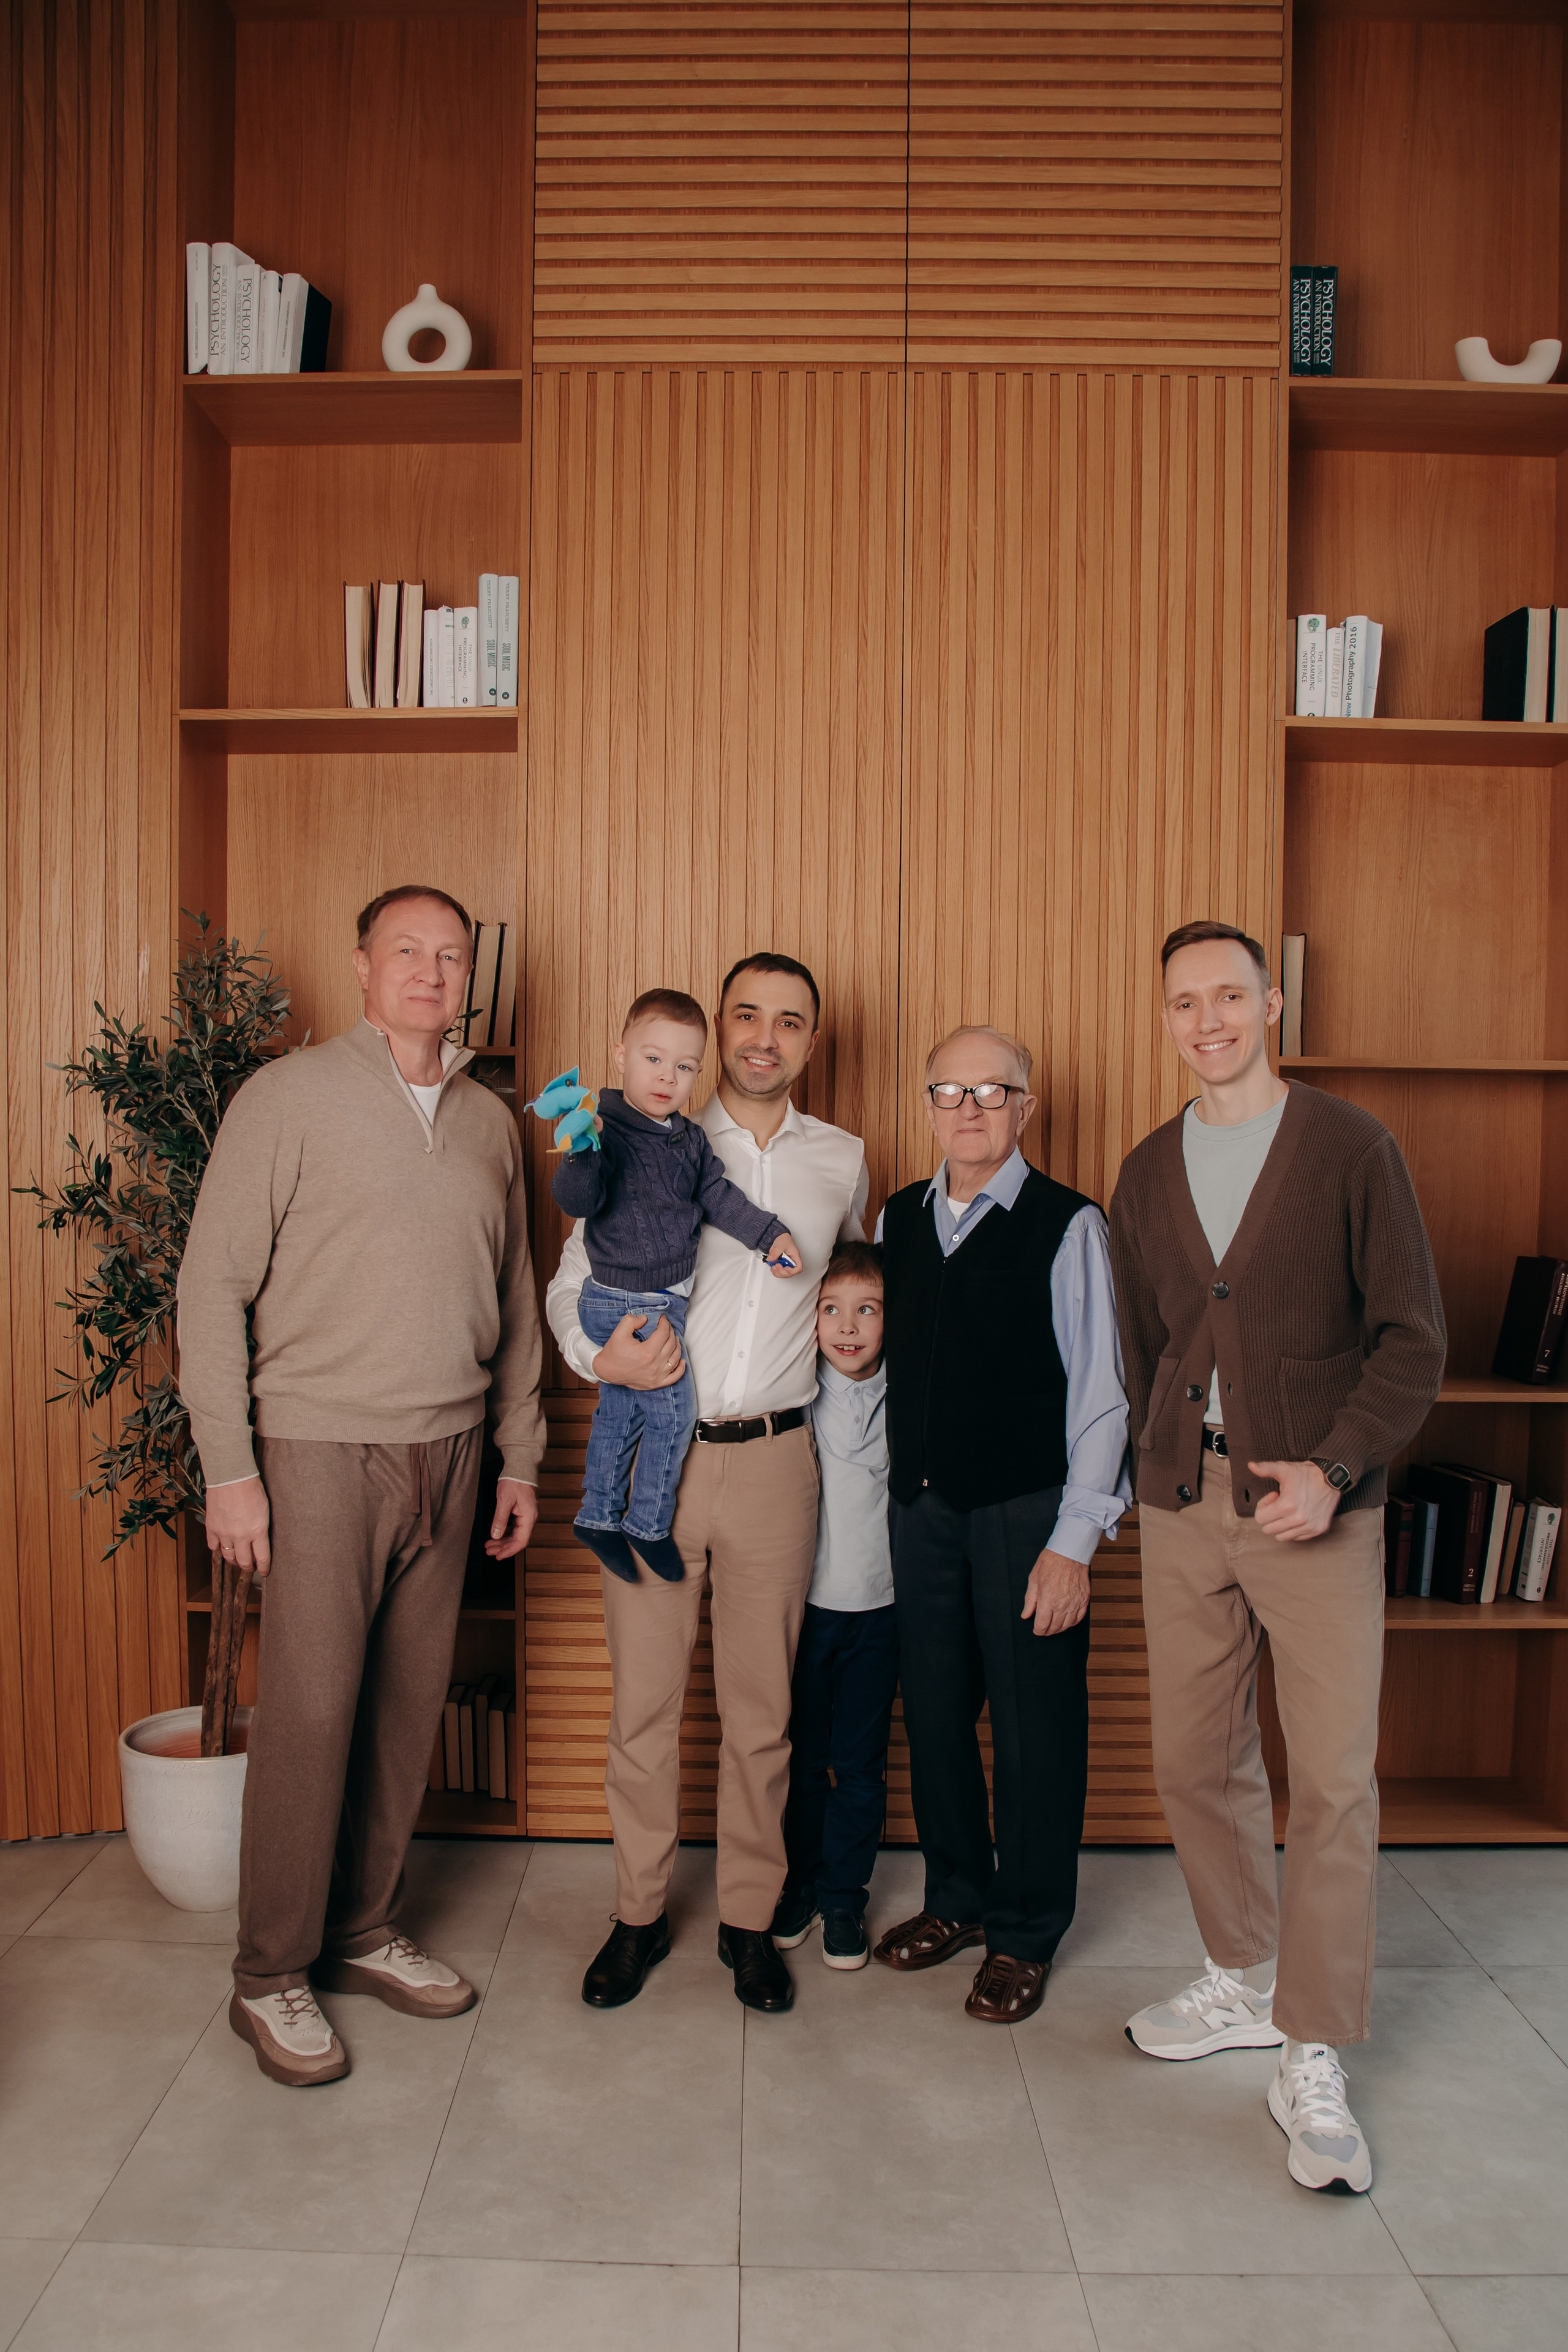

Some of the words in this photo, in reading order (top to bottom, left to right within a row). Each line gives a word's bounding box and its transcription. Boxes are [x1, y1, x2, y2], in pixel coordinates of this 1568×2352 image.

[236, 280, 241, 290] AN
[1293, 279, 1300, 291] AN
[1316, 281, 1322, 292] AN
[210, 264, 221, 356] PSYCHOLOGY
[241, 277, 252, 363] PSYCHOLOGY
[1300, 279, 1311, 366] PSYCHOLOGY
[1321, 279, 1334, 366] PSYCHOLOGY
[221, 346, 226, 355] AN
[502, 643, 511, 654] SOUL
[502, 655, 511, 671] MUSIC
[1330, 648, 1341, 698] LIBERATED
[1346, 651, 1355, 701] Photography
[1545, 1349, 1550, 1358] 7
[1541, 1532, 1550, 1570] PROGRAMMING
[1468, 1568, 1474, 1577] 2
